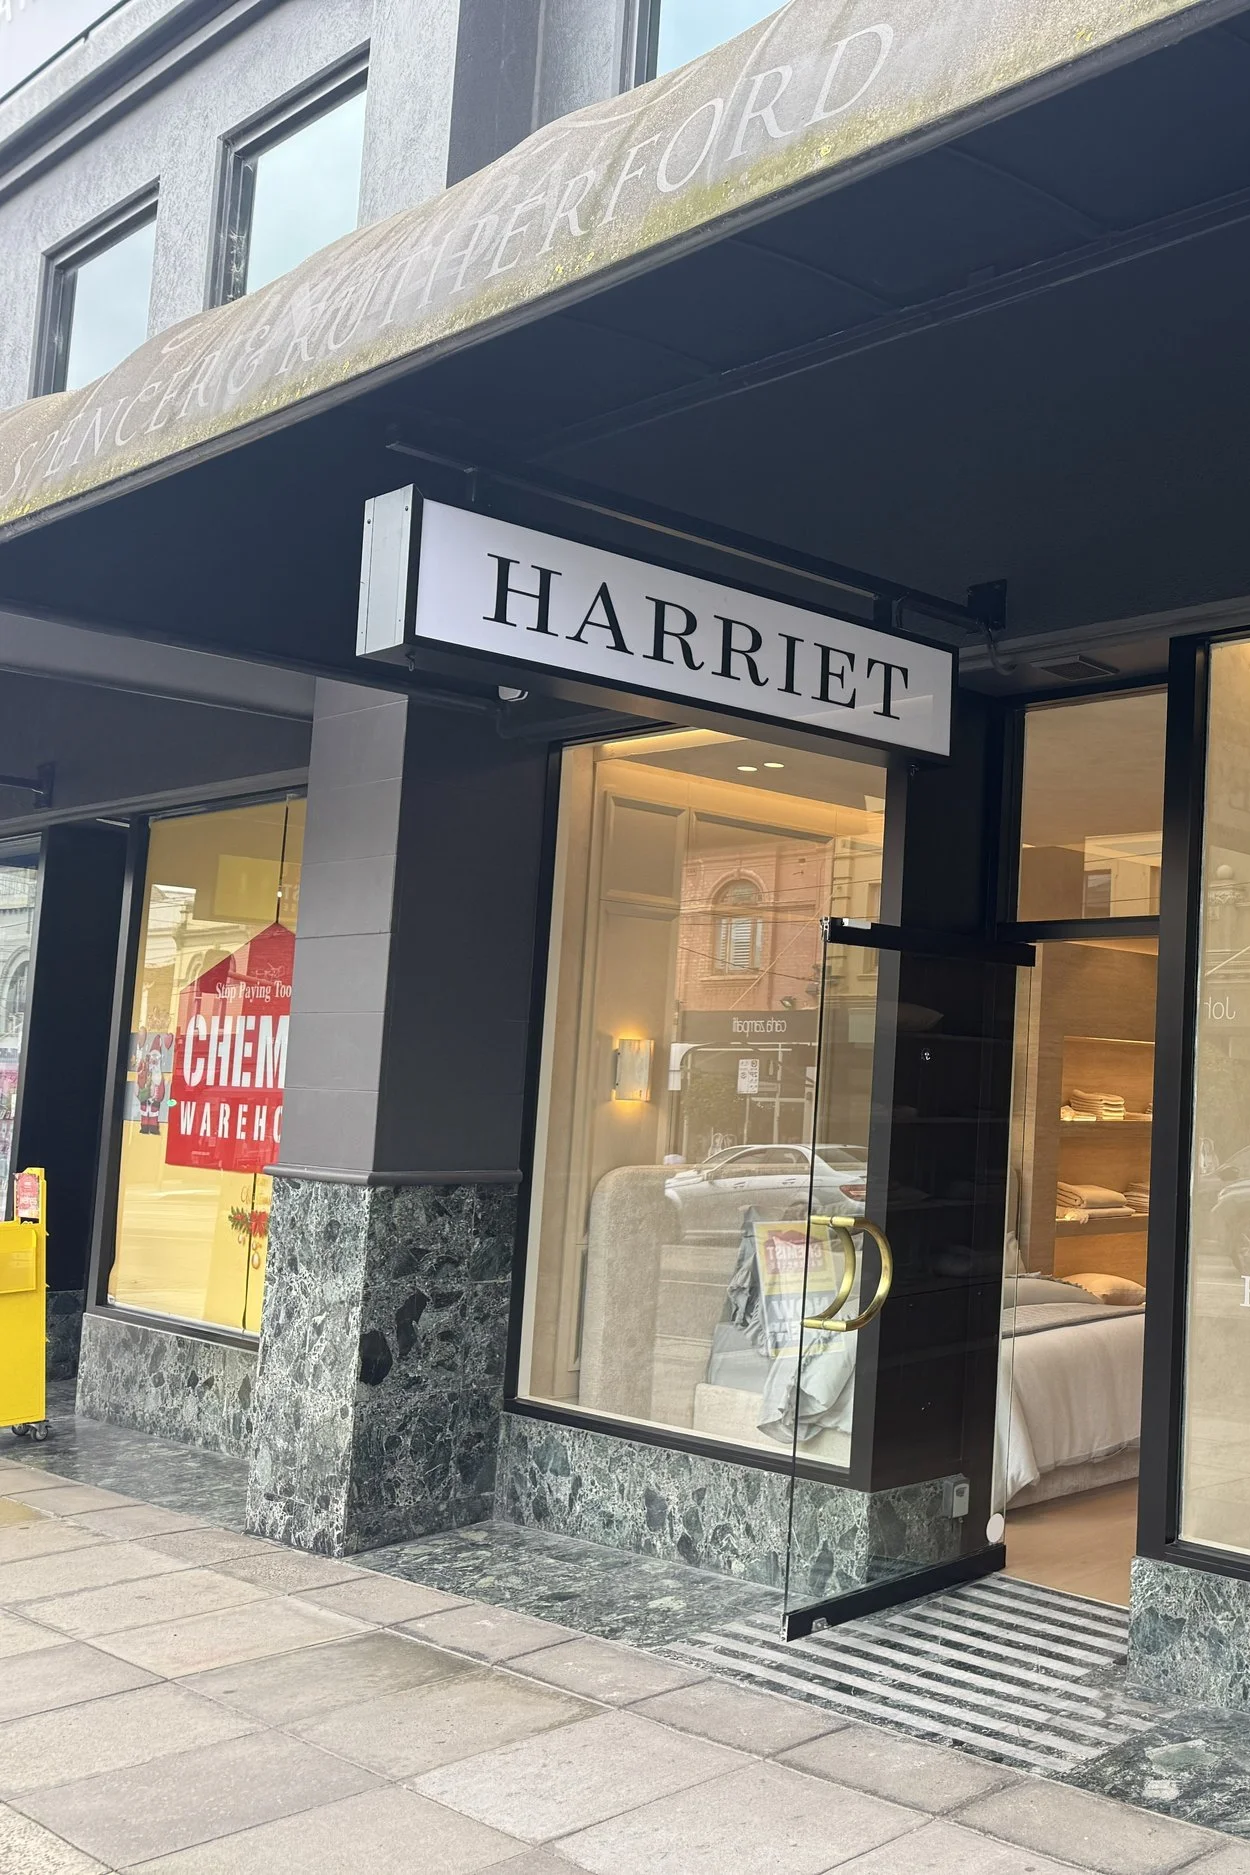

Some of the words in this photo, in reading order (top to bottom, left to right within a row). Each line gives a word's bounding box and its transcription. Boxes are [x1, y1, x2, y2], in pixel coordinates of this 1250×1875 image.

[0, 351, 222, 496] SPENCER
[275, 22, 894, 376] RUTHERFORD
[482, 552, 910, 721] HARRIET
[183, 1014, 290, 1089] CHEM
[215, 982, 237, 1003] Stop
[238, 981, 271, 1002] Paying
[274, 980, 292, 998] Too
